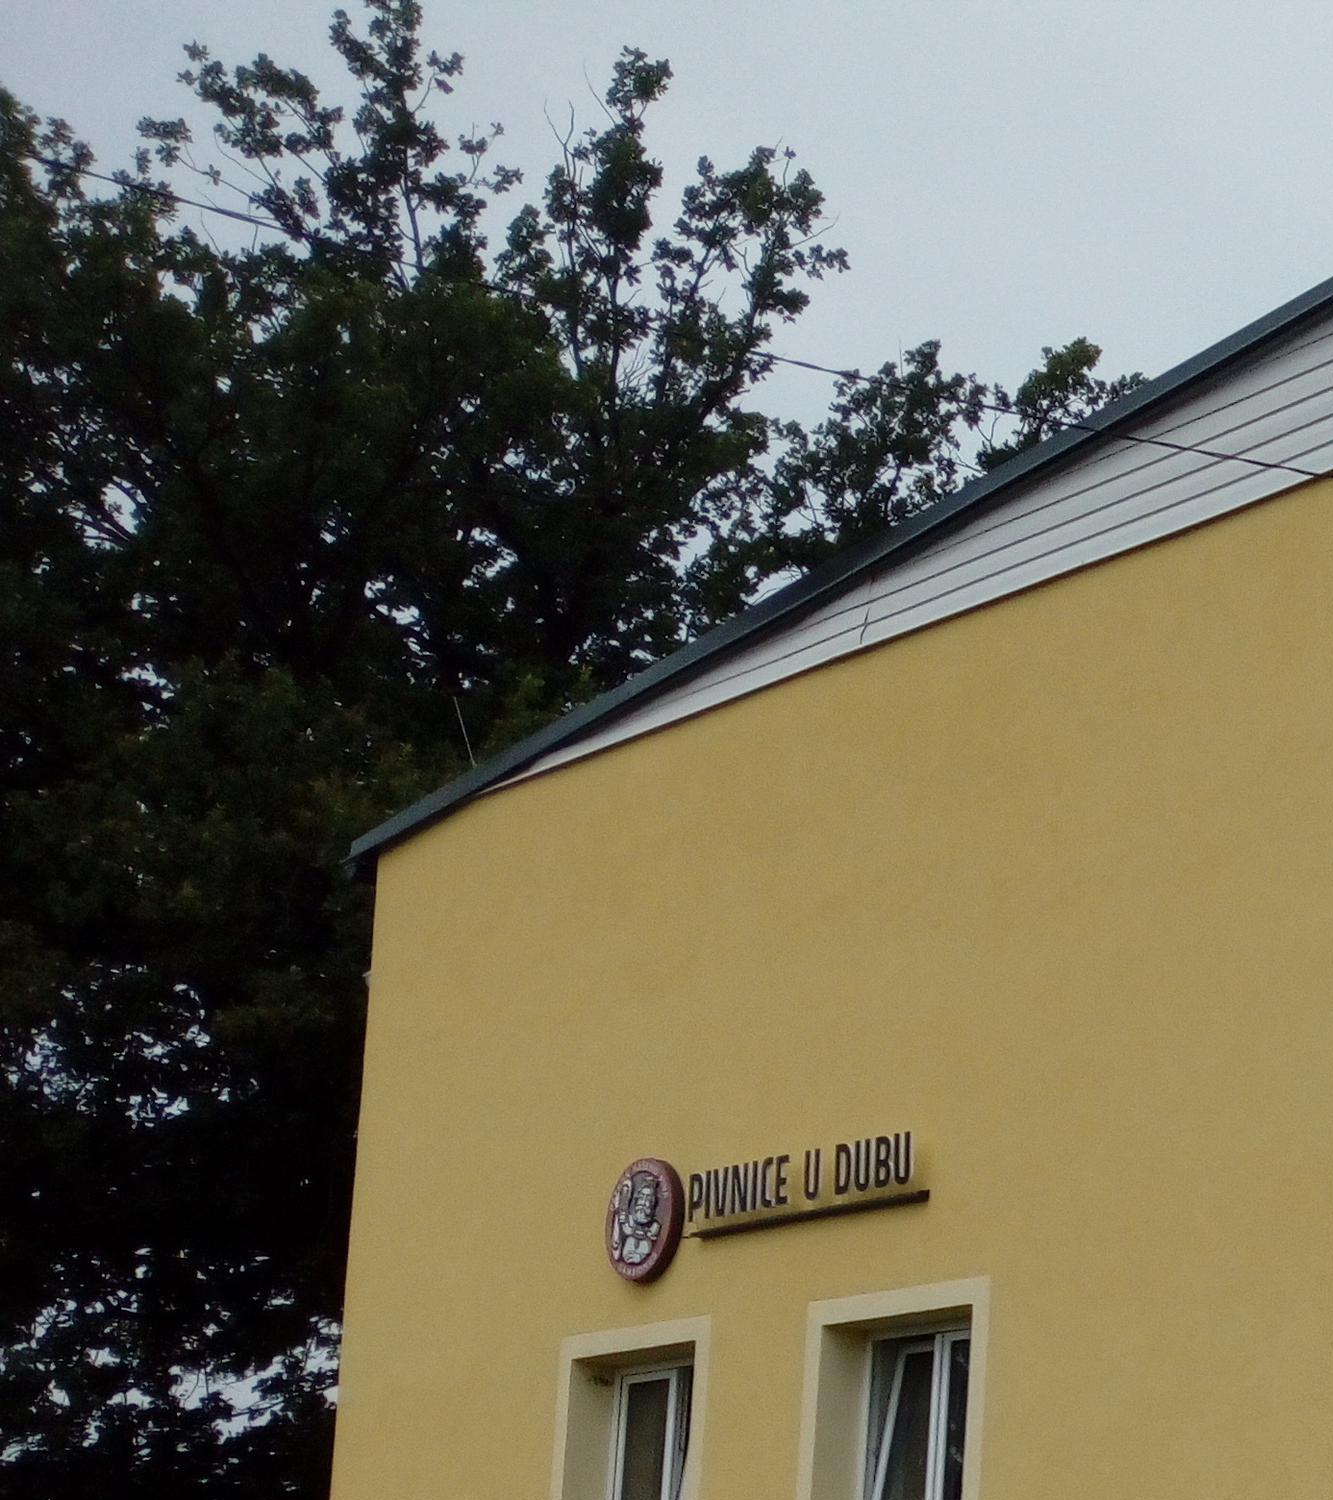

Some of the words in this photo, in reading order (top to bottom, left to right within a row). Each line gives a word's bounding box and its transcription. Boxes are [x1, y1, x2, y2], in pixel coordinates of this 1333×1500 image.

[687, 1154, 790, 1223] PIVNICE
[804, 1148, 820, 1200] U
[835, 1131, 912, 1196] DUBU
